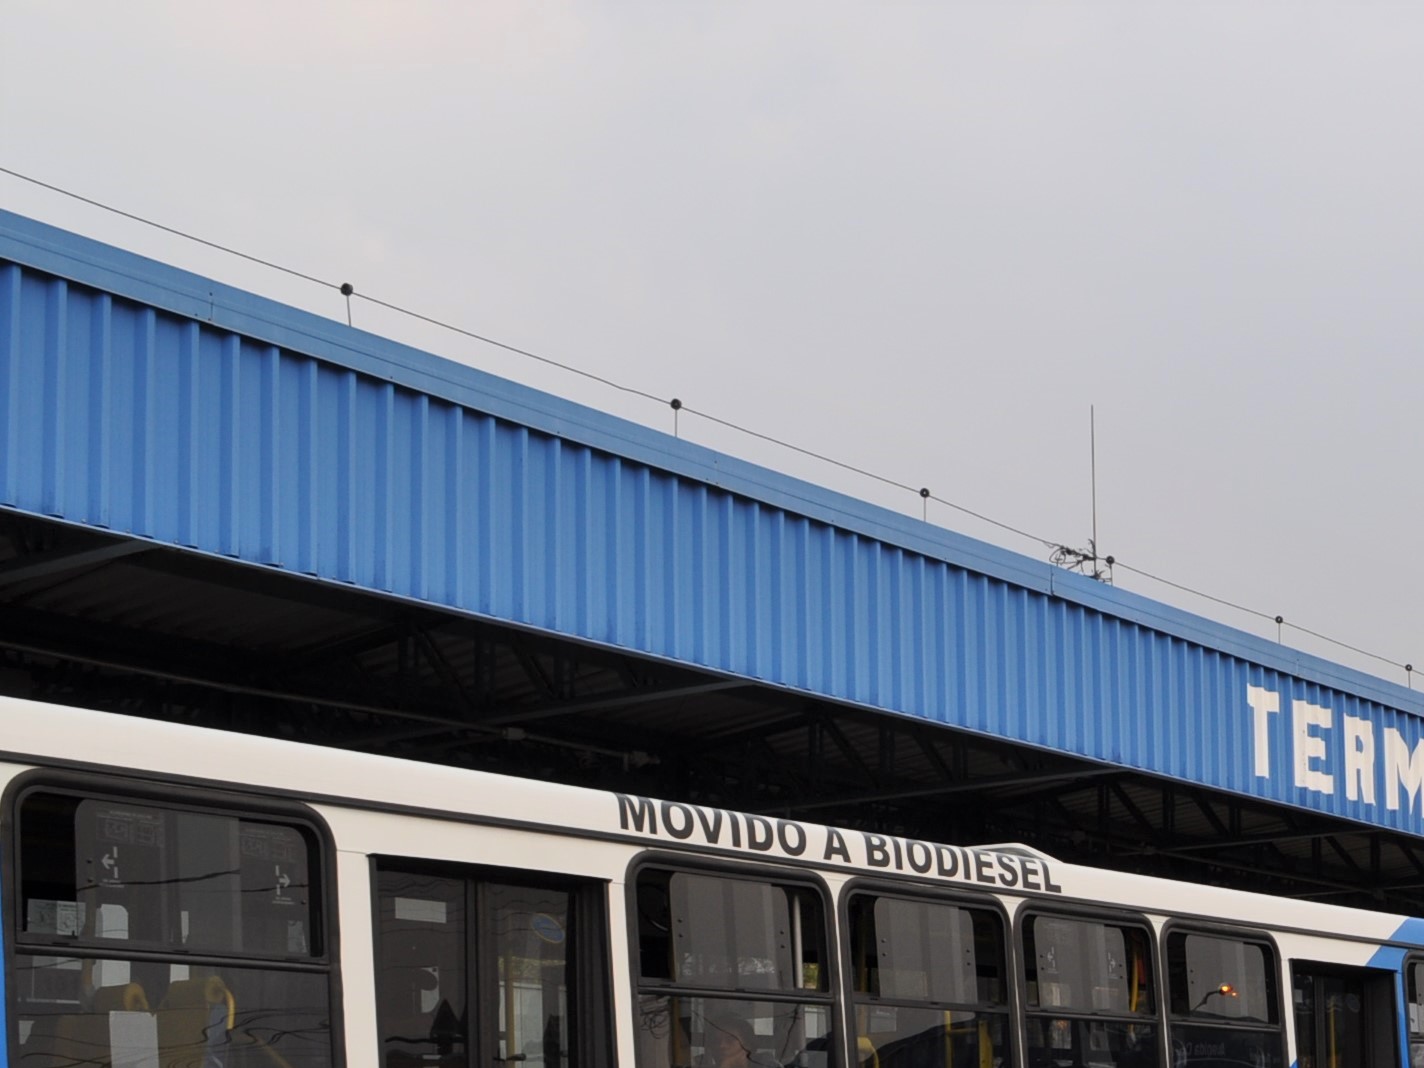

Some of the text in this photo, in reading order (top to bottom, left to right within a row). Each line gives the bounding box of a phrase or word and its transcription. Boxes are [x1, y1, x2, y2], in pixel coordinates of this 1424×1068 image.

[615, 793, 1062, 893] MOVIDO A BIODIESEL
